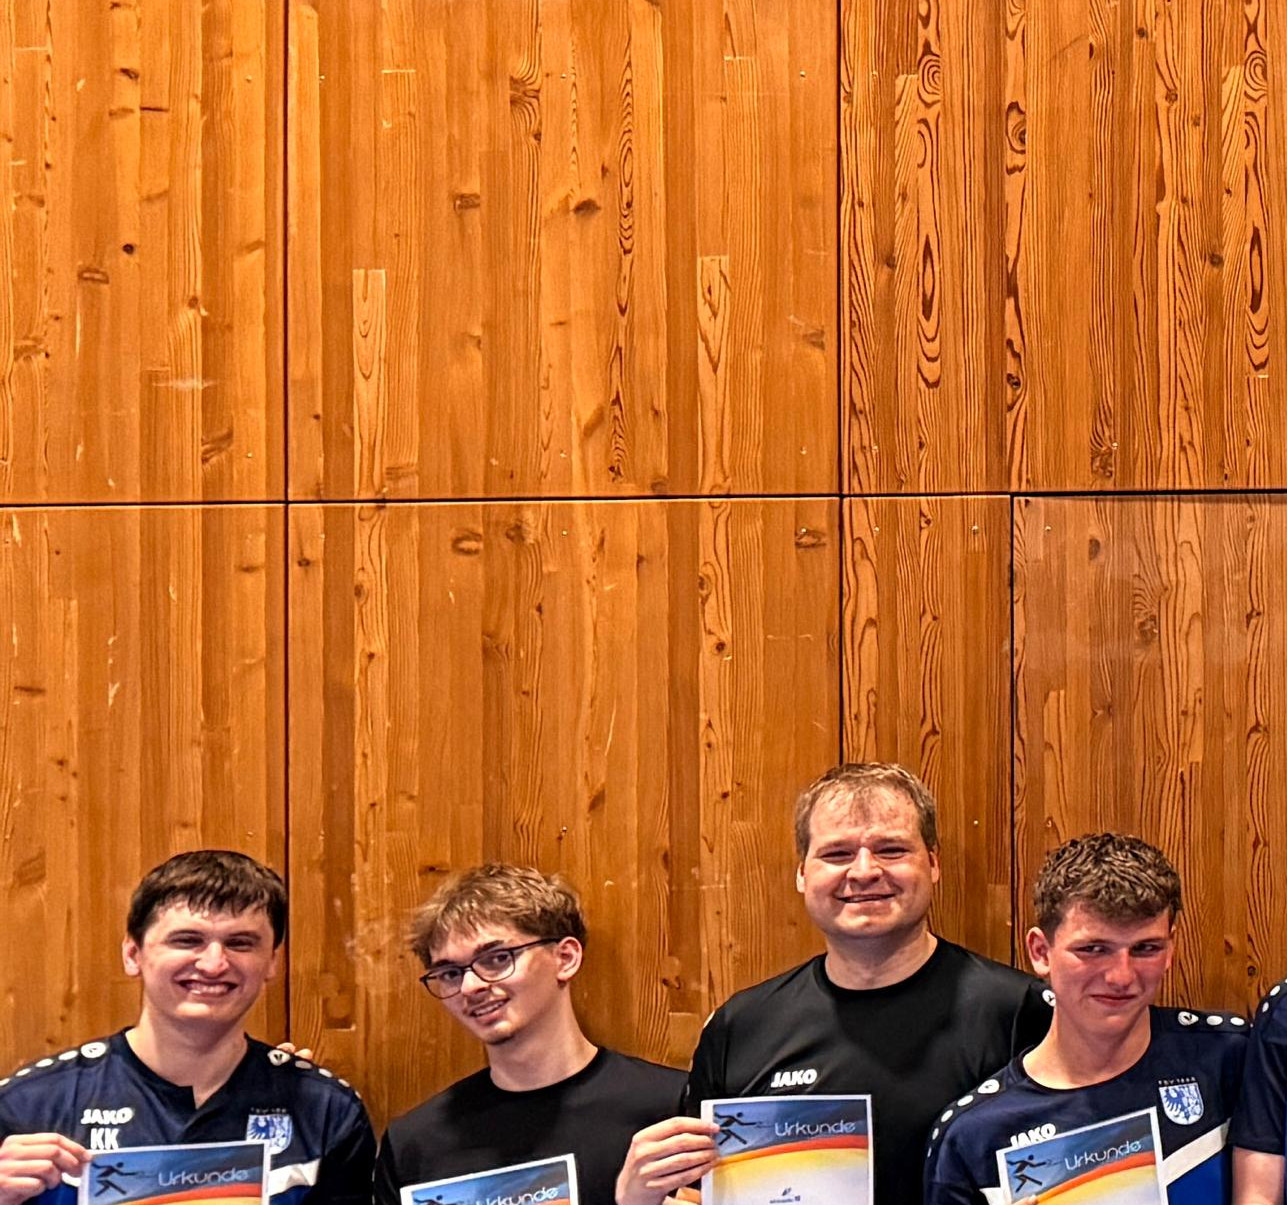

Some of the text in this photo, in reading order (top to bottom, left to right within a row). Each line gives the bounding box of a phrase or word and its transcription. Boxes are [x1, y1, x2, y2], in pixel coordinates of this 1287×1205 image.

[770, 1069, 818, 1088] JAKO
[80, 1107, 134, 1125] JAKO
[774, 1119, 856, 1137] Urkunde
[1010, 1123, 1056, 1147] JAKO
[90, 1128, 119, 1150] KK
[1064, 1140, 1142, 1171] Urkunde
[158, 1167, 249, 1187] Urkunde
